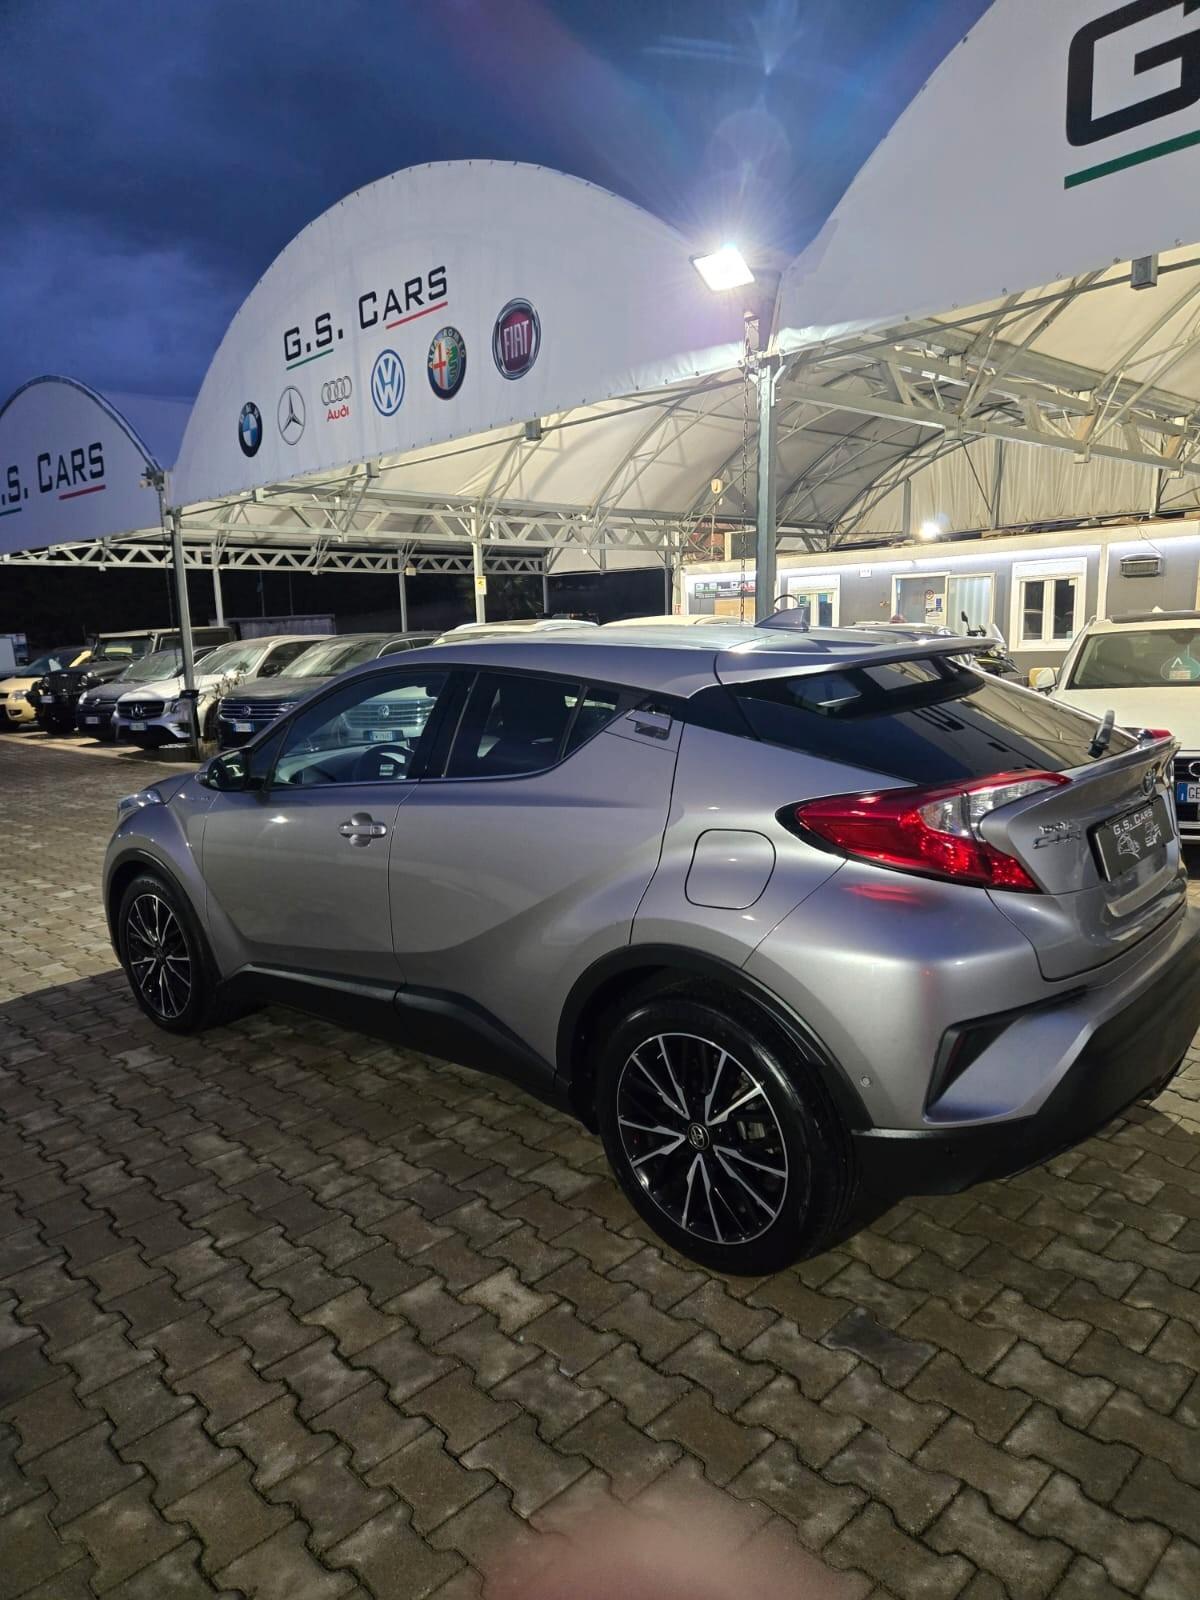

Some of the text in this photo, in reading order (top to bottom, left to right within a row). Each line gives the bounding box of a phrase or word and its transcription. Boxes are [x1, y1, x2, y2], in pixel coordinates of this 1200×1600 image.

[284, 265, 447, 361] G.S. CARS
[503, 319, 530, 361] FIAT
[326, 404, 350, 422] Audi
[37, 442, 105, 493] CARS
[1112, 819, 1133, 835] G.S.
